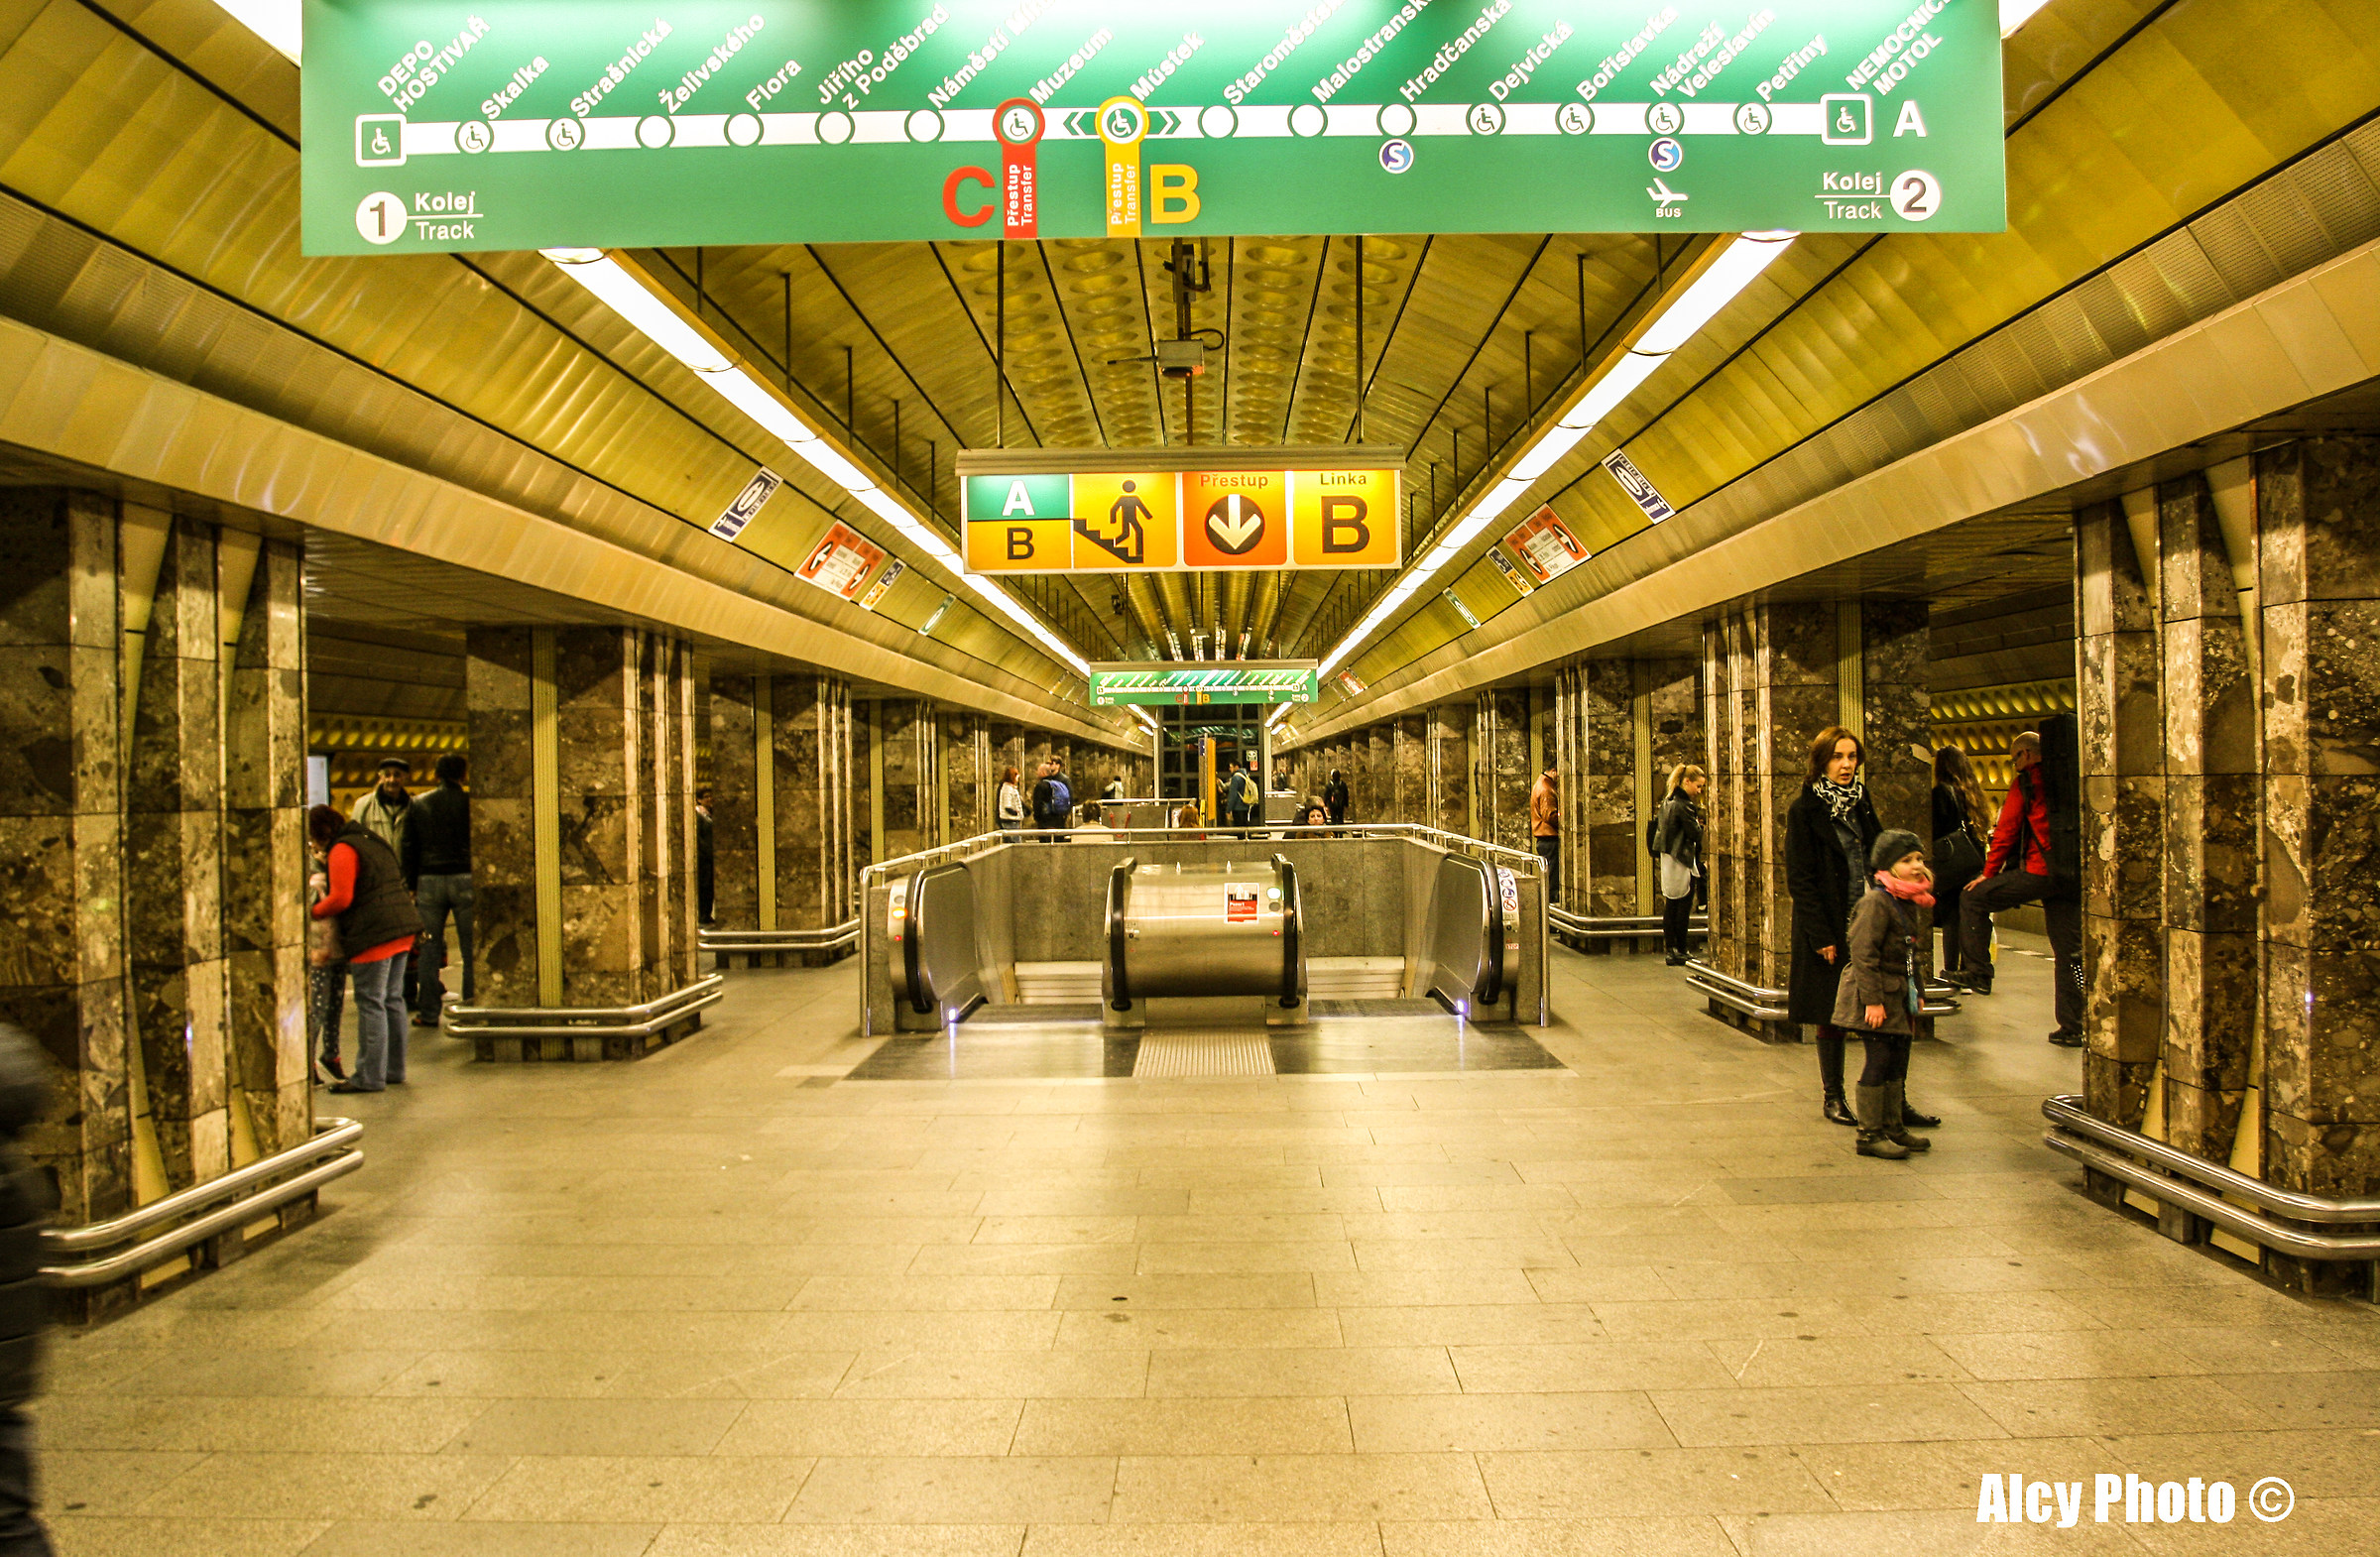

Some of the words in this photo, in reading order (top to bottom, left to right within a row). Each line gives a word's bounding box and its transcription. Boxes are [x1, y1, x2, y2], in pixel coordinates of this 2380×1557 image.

[377, 40, 434, 97] DEPO
[393, 14, 491, 113] HOSTIVAŘ
[569, 17, 673, 117] Strašnická
[657, 14, 765, 114] Želivského
[842, 92, 860, 110] z
[855, 2, 950, 95] Poděbrad
[927, 26, 1011, 109] Náměstí
[1027, 27, 1115, 105] Muzeum
[1223, 0, 1346, 105] Staroměstsk
[1311, 0, 1432, 103] Malostransk
[1488, 20, 1575, 101] Dejvická
[1575, 5, 1680, 101] Bořislavka
[1649, 20, 1726, 97] Nádraží
[1676, 8, 1776, 98] Veleslavín
[1755, 33, 1830, 102] Petřiny
[1844, 0, 1952, 92] NEMOCNIC
[1871, 32, 1944, 95] MOTOL
[480, 56, 549, 120] Skalka
[745, 60, 802, 111] Flora
[818, 49, 874, 104] Jiřího
[1892, 100, 1928, 138] A
[415, 190, 476, 214] Kolej
[942, 166, 996, 228] C
[1007, 164, 1020, 226] Přestup
[1020, 165, 1033, 226] Transfer
[1125, 164, 1136, 224] Transfer
[1150, 164, 1201, 224] B
[1655, 207, 1683, 218] BUS
[1822, 172, 1883, 195] Kolej
[1823, 200, 1883, 220] Track
[1902, 177, 1928, 213] 2
[369, 199, 386, 237] 1
[415, 220, 475, 240] Track
[1002, 480, 1035, 516] A
[1200, 473, 1268, 489] Přestup
[1320, 472, 1368, 486] Linka
[1006, 527, 1035, 560] B
[1321, 495, 1370, 553] B
[1175, 694, 1184, 704] C
[1202, 693, 1211, 704] B
